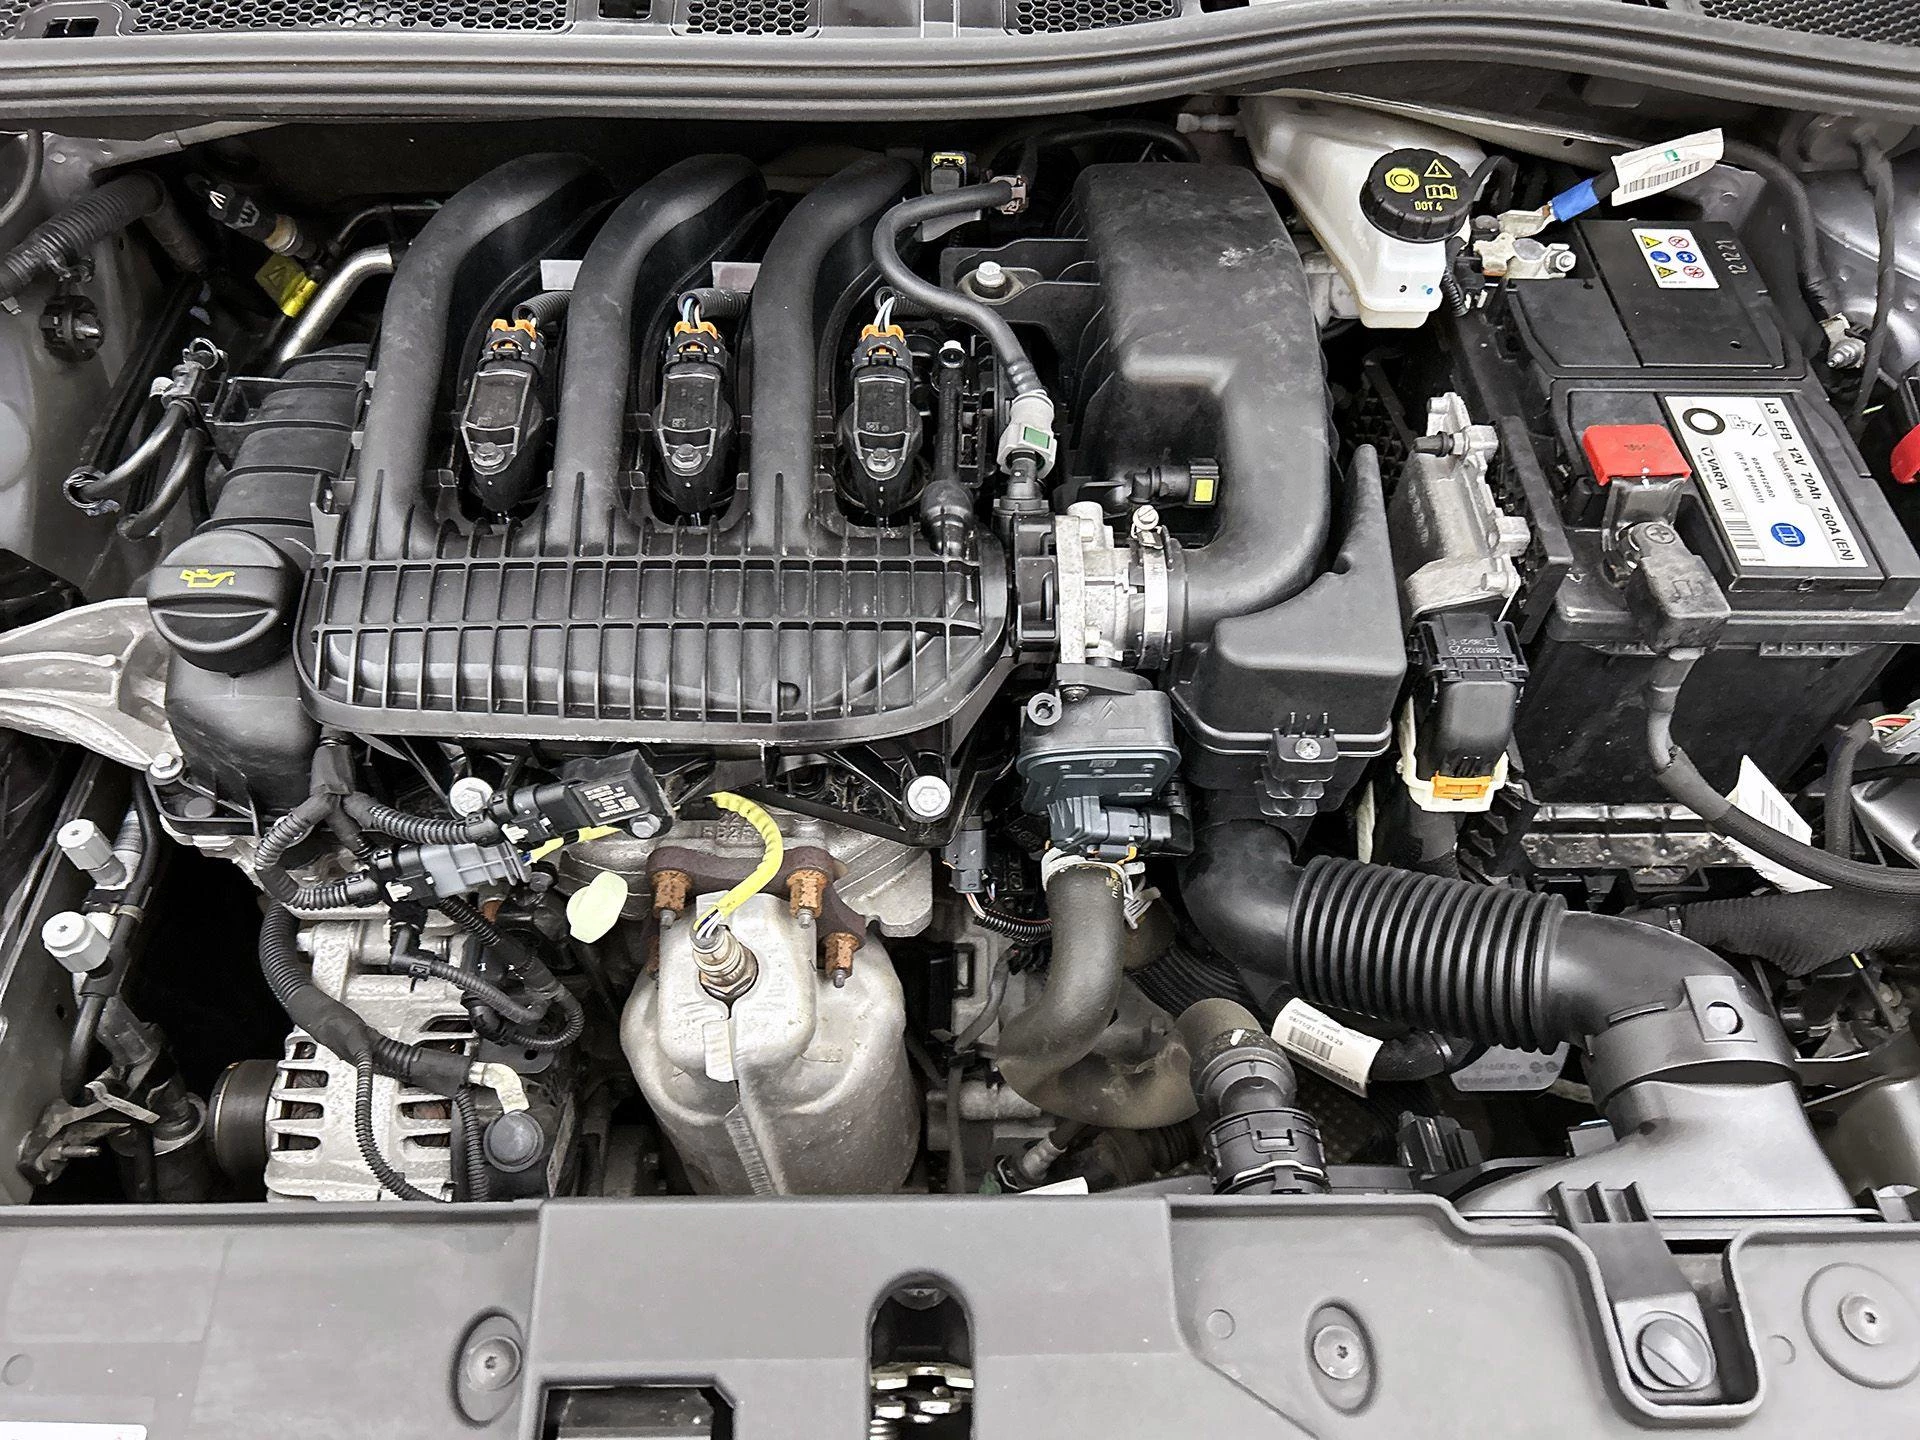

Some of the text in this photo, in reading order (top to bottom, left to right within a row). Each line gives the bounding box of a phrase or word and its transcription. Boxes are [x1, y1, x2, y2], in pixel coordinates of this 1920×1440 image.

[1414, 201, 1444, 212] DOT 4
[1707, 458, 1728, 490] VARTA
[1763, 402, 1856, 561] L3 EFB 12V 70Ah 760A (EN)
